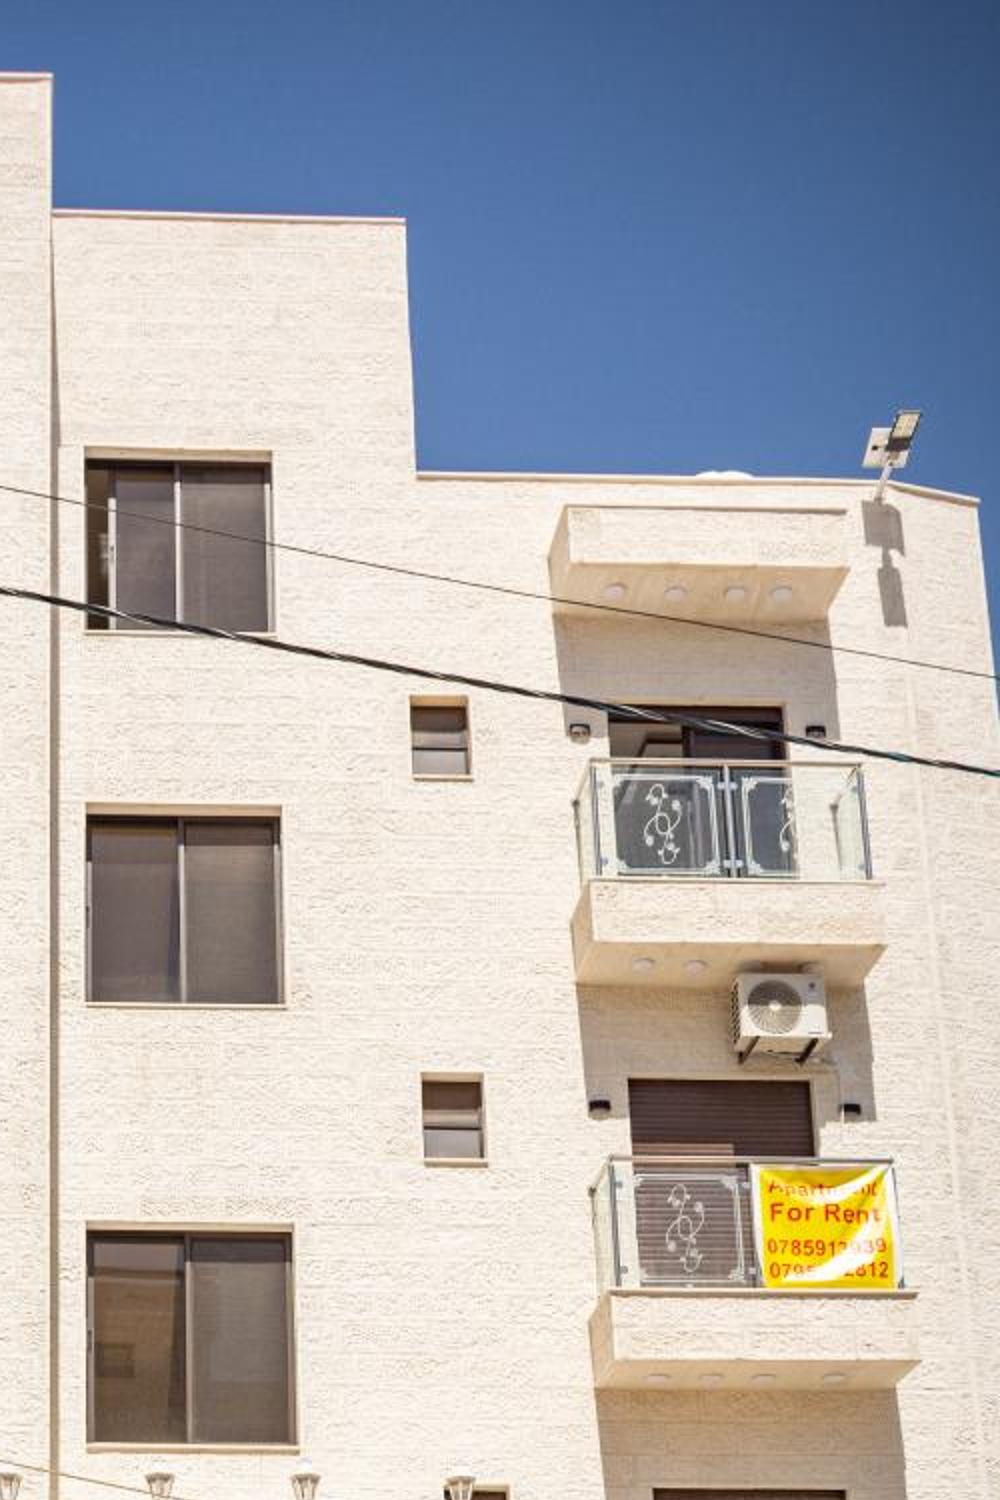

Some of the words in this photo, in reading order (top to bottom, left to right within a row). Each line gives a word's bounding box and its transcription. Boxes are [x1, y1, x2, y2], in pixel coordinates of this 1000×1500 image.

[769, 1179, 877, 1197] Apartnt
[770, 1202, 815, 1222] For
[824, 1203, 881, 1224] Rent
